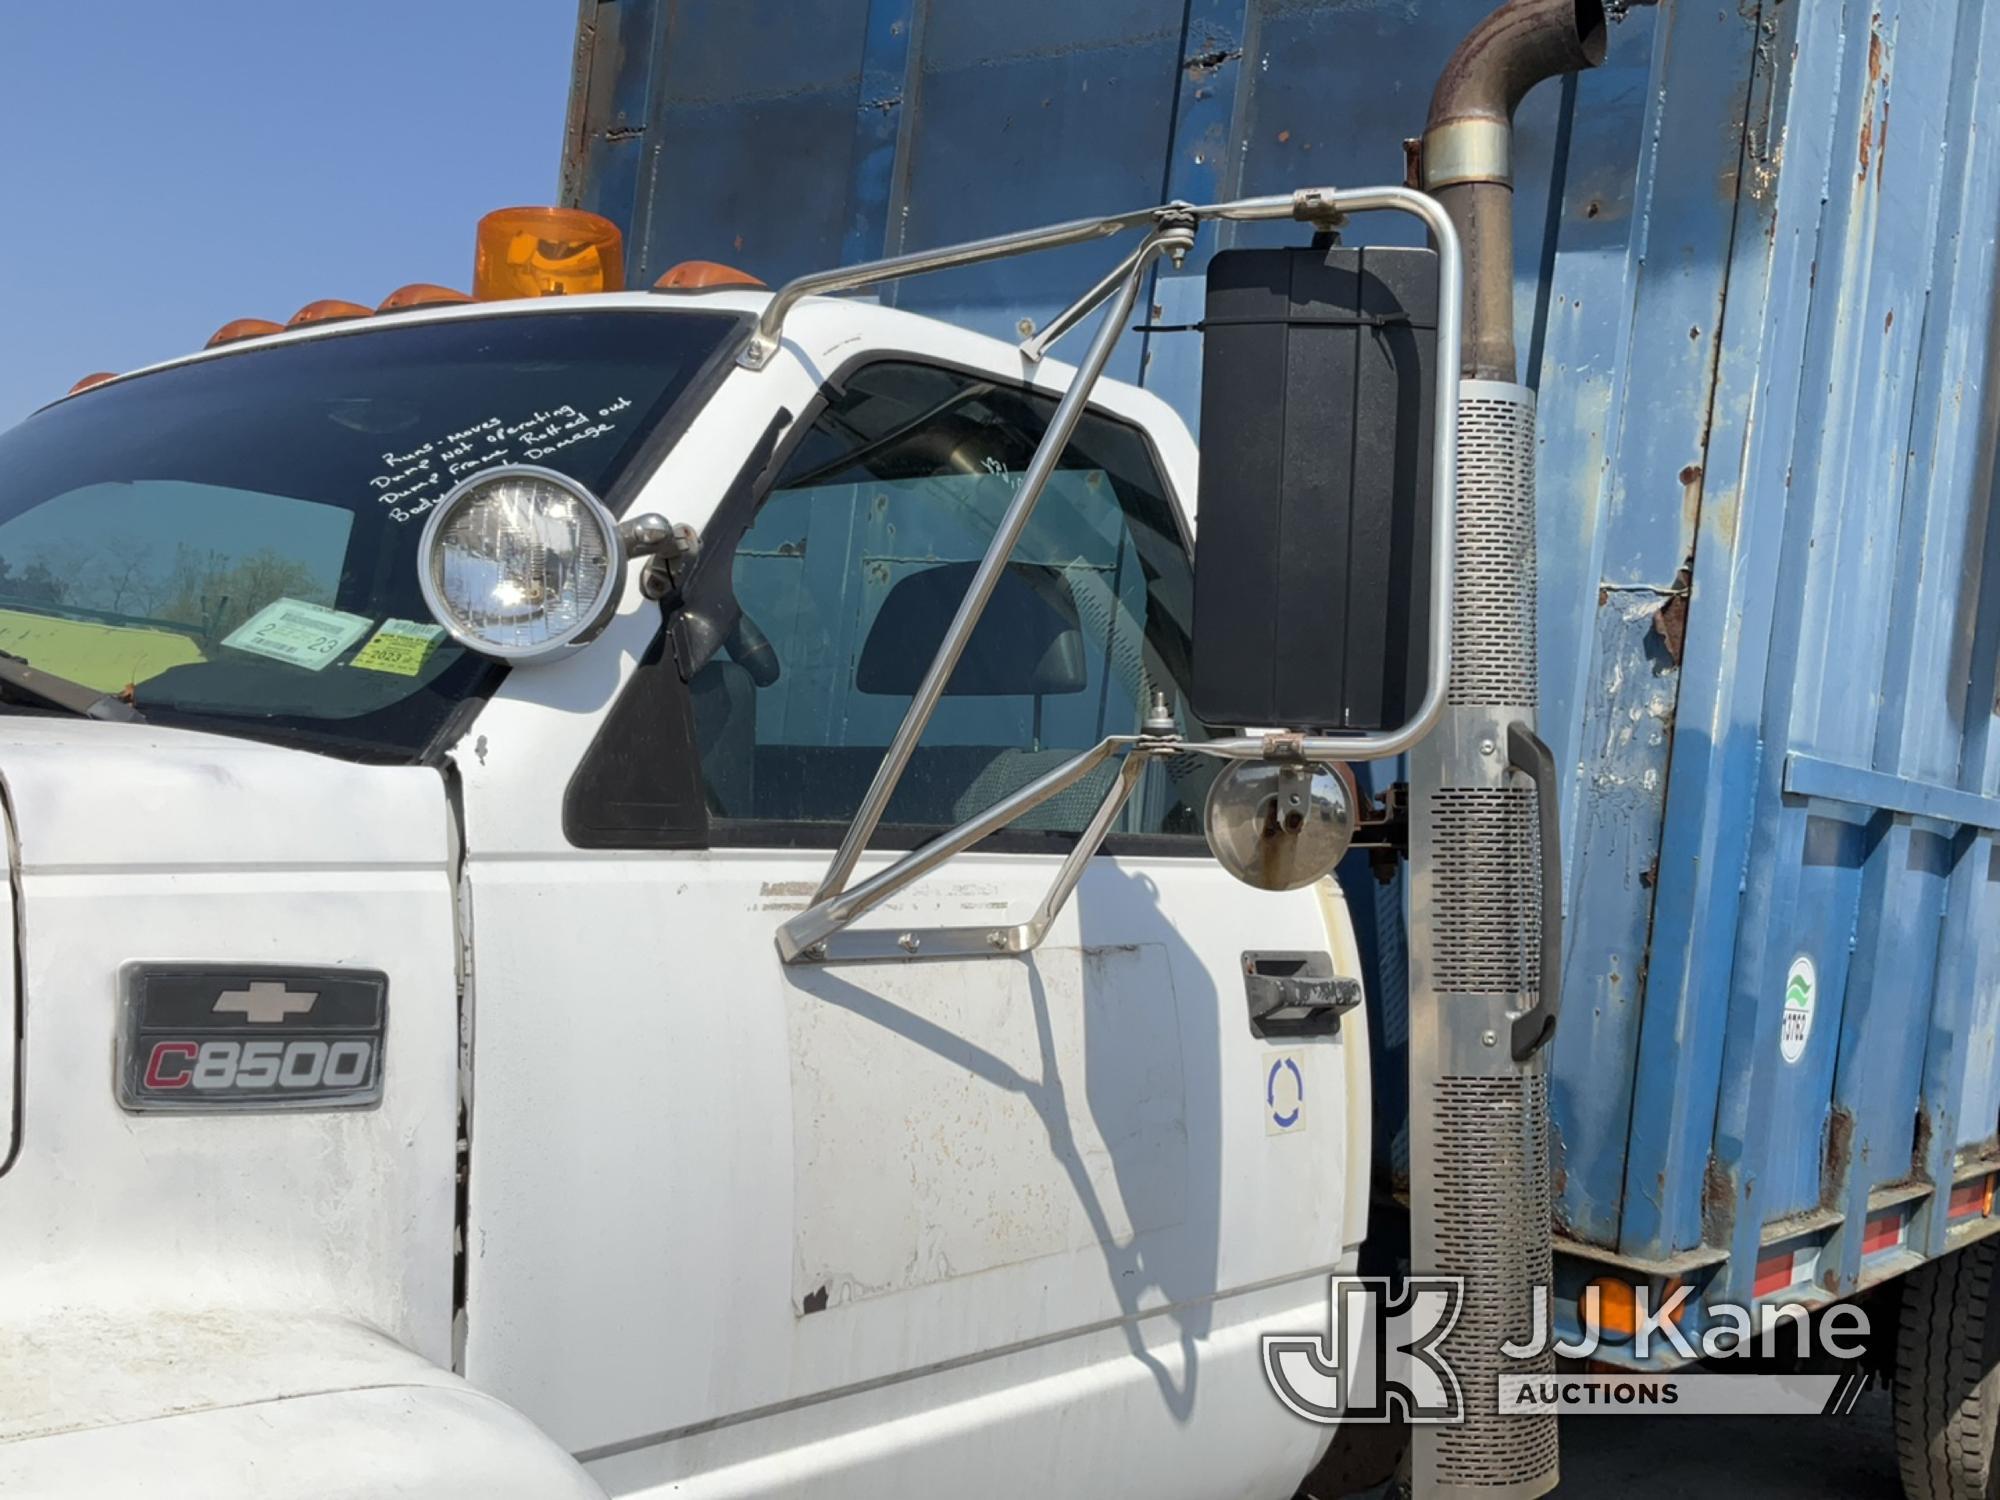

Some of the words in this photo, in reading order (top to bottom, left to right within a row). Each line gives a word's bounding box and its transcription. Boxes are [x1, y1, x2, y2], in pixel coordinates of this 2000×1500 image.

[378, 472, 440, 504] Dump
[449, 448, 508, 475] Frame
[598, 396, 632, 416] out
[440, 442, 473, 462] Not
[523, 423, 616, 460] Damage
[382, 443, 434, 466] Runs
[307, 636, 339, 654] 23
[371, 650, 402, 662] 2023
[143, 1040, 371, 1089] C8500
